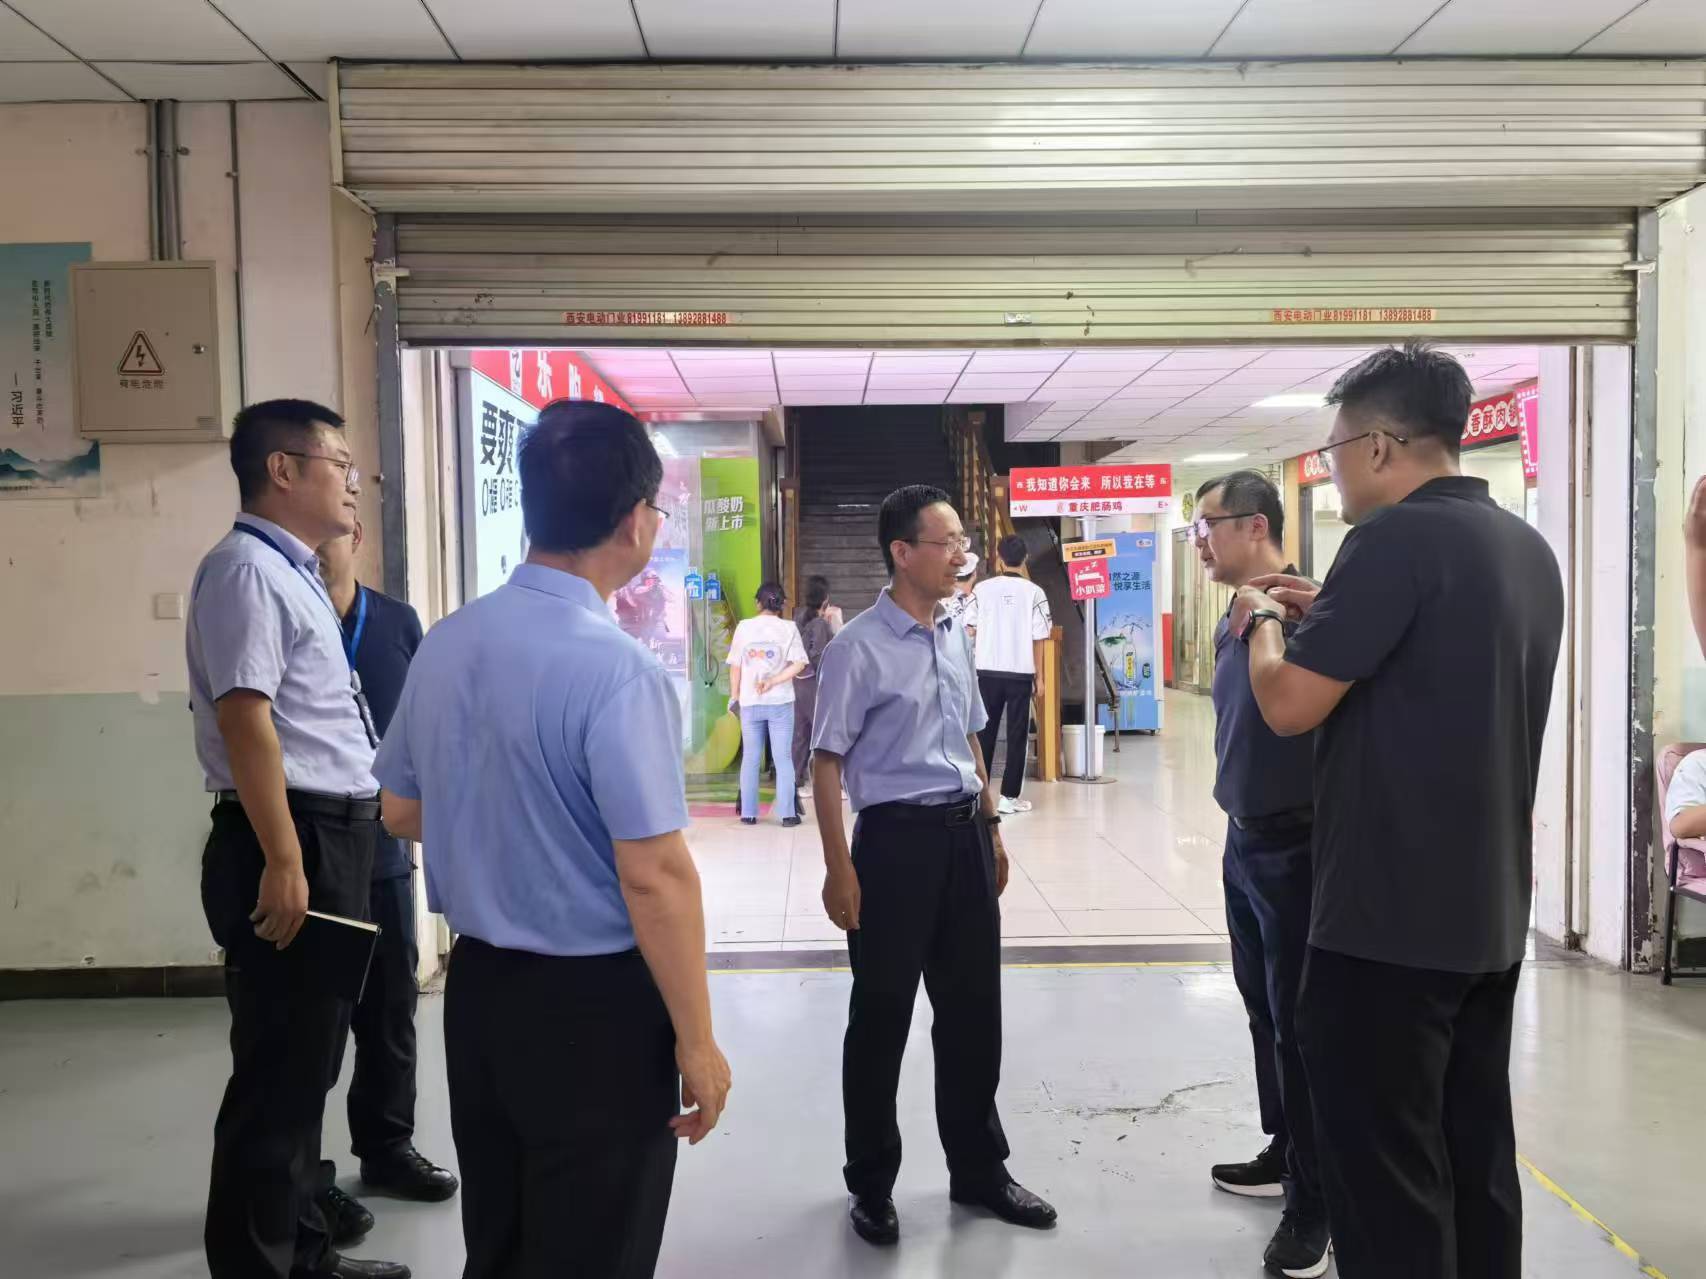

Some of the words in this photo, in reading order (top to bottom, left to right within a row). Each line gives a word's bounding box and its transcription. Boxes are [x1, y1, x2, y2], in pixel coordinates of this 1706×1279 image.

[1274, 309, 1372, 321] 西安电动门业81991181
[1379, 309, 1432, 321] 13892881488
[1026, 476, 1091, 492] 我知道你会来
[1019, 504, 1028, 512] W
[1069, 501, 1123, 513] 重庆肥肠鸡
[1110, 572, 1141, 582] 然之源
[1114, 581, 1151, 591] 悦享生活
